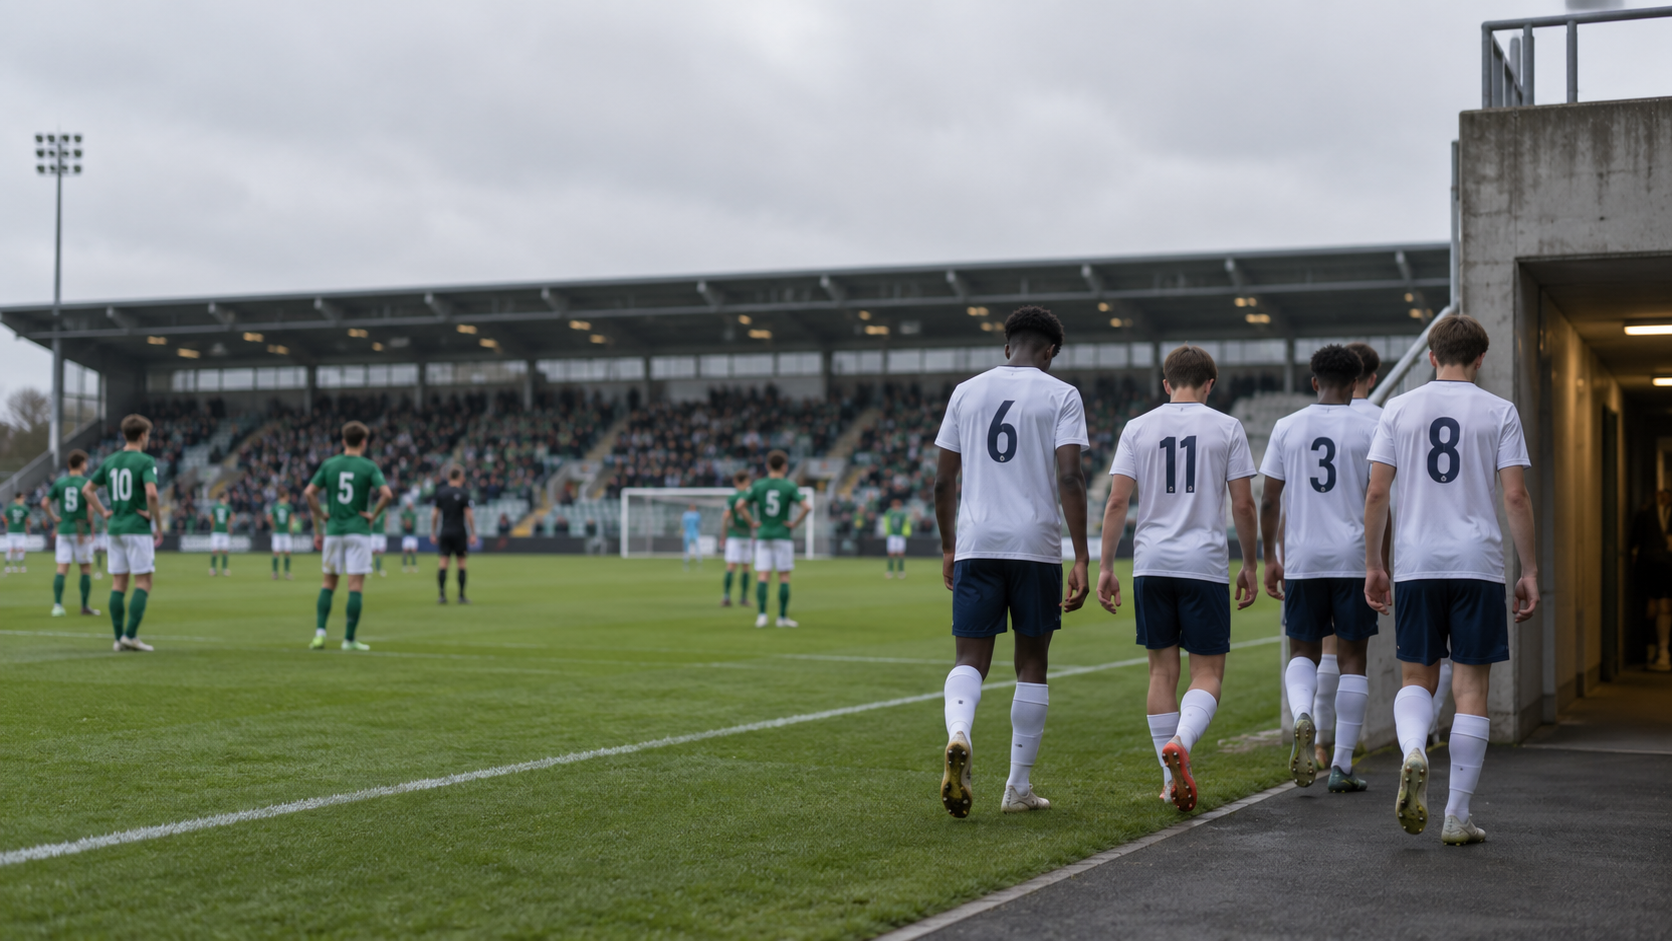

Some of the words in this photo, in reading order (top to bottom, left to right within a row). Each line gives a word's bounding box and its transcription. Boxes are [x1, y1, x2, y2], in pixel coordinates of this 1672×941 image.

[987, 400, 1017, 463] 6
[1427, 417, 1460, 484] 8
[109, 468, 132, 501] 10
[338, 471, 354, 504] 5
[1159, 437, 1196, 494] 11
[1310, 437, 1336, 493] 3
[766, 490, 779, 515] 5
